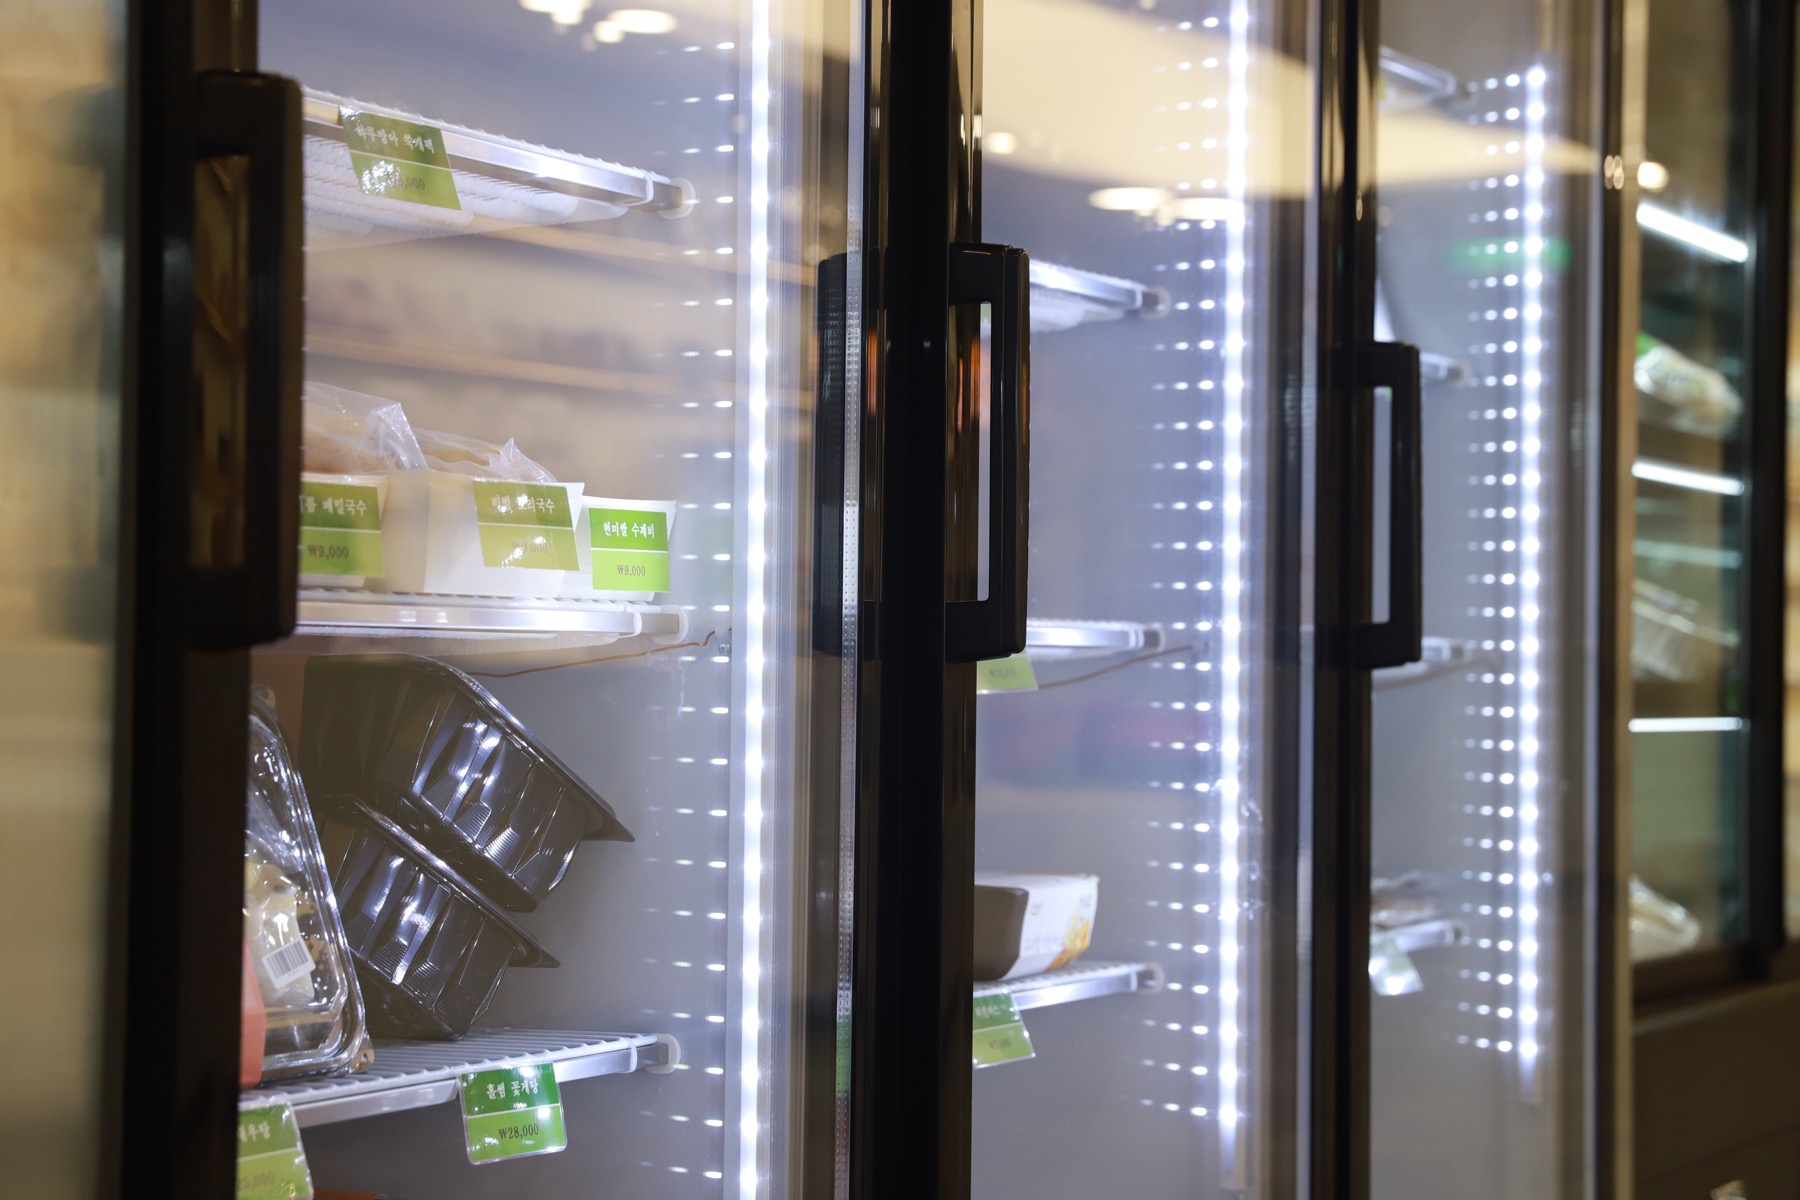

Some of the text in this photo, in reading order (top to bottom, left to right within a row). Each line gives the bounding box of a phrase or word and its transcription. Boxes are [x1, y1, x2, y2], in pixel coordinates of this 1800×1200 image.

[603, 521, 655, 539] 현미쌀 수제비
[308, 544, 349, 560] ₩9,000
[617, 564, 646, 578] ₩9,000
[511, 1078, 539, 1097] 꽃게탕
[498, 1123, 539, 1139] ₩28,000
